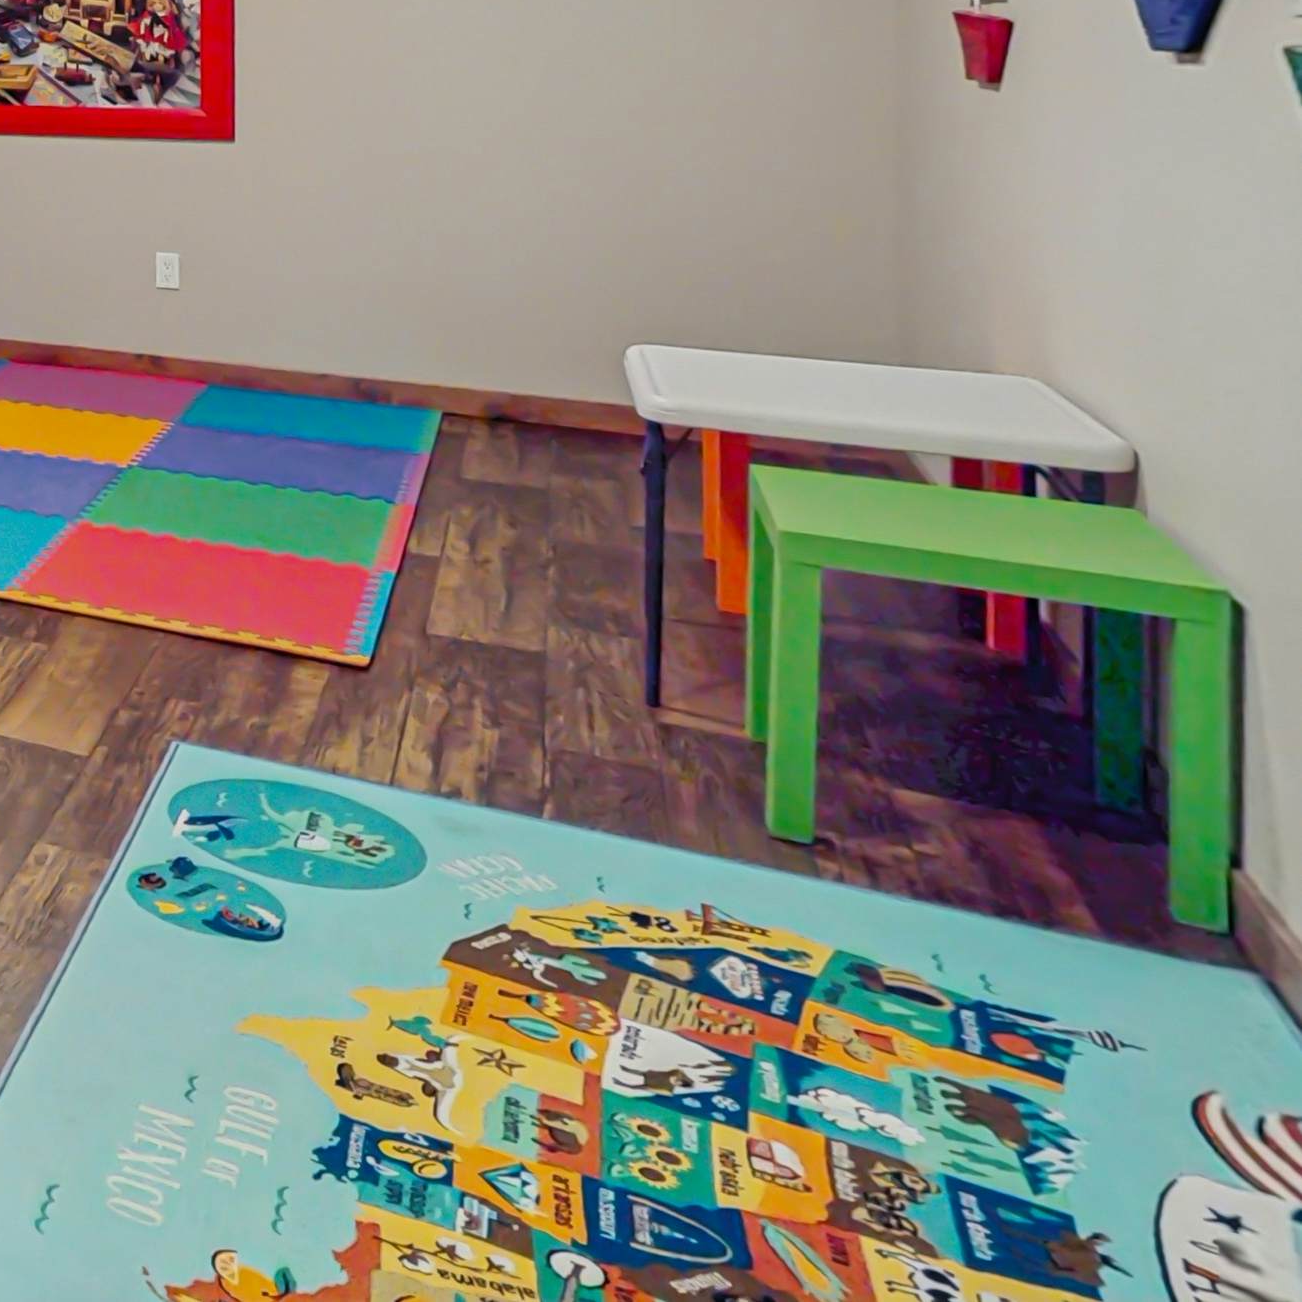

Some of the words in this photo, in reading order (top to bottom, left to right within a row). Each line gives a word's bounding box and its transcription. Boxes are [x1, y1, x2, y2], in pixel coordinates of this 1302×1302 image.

[105, 1103, 195, 1226] MEXICO
[214, 1085, 279, 1167] GULF
[436, 1267, 537, 1300] alabama
